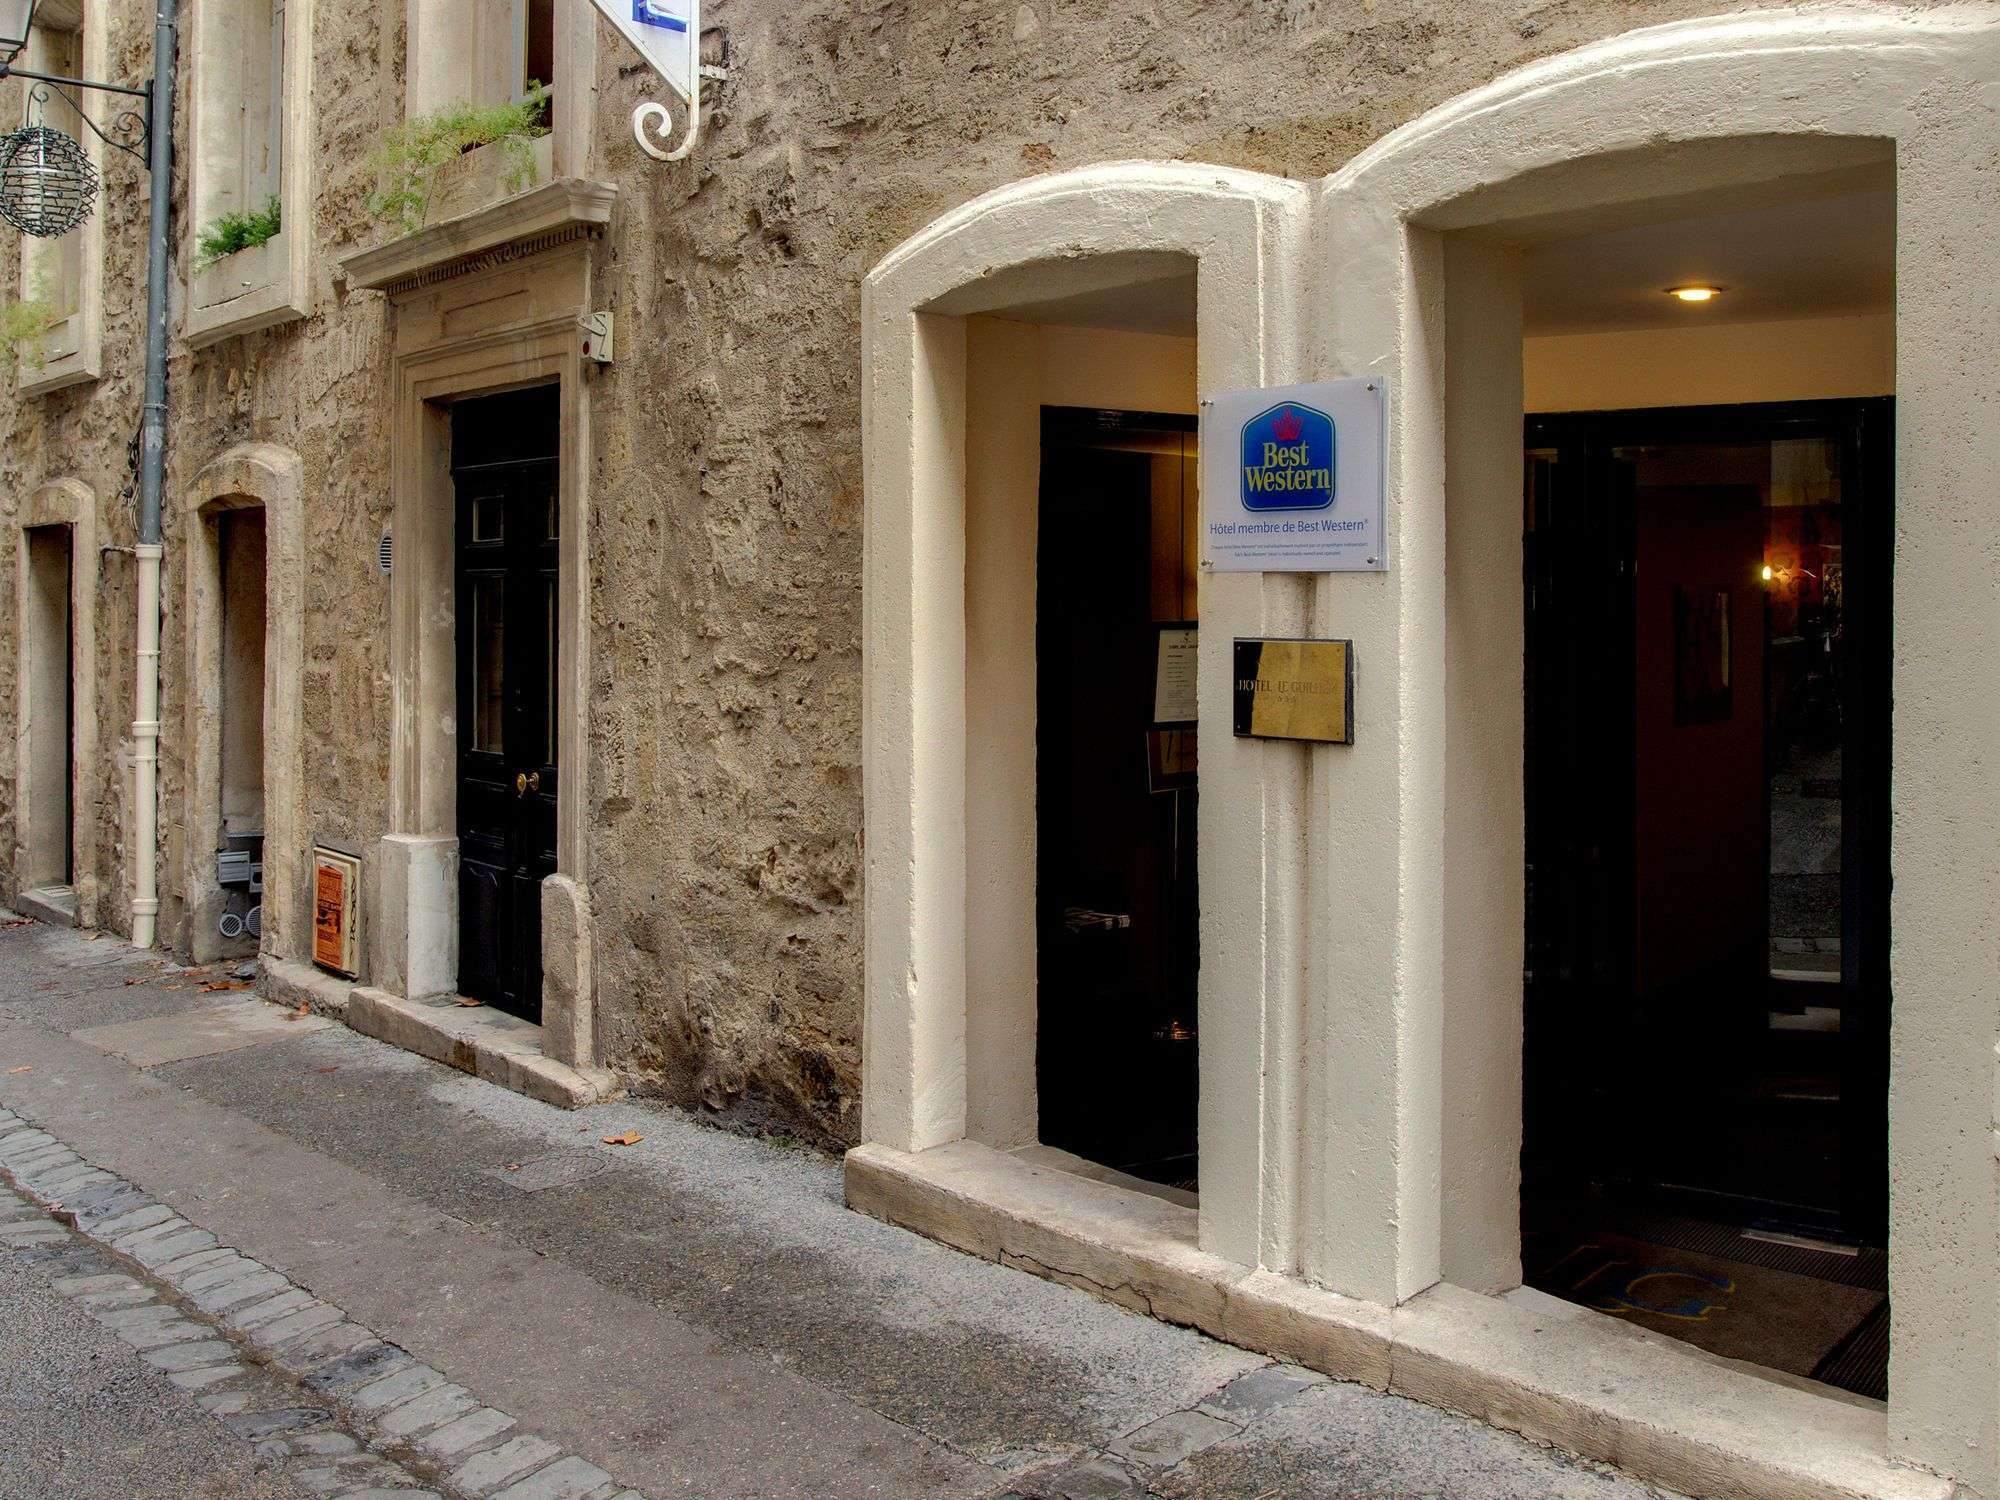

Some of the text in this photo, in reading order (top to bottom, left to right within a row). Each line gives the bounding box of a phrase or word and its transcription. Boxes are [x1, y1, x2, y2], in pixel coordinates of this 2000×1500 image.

[1262, 440, 1310, 468] Best
[1245, 464, 1331, 493] Western
[1210, 522, 1236, 535] Hôtel
[1238, 521, 1280, 534] membre
[1282, 521, 1295, 533] de
[1297, 520, 1319, 533] Best
[1239, 679, 1273, 692] HOTEL
